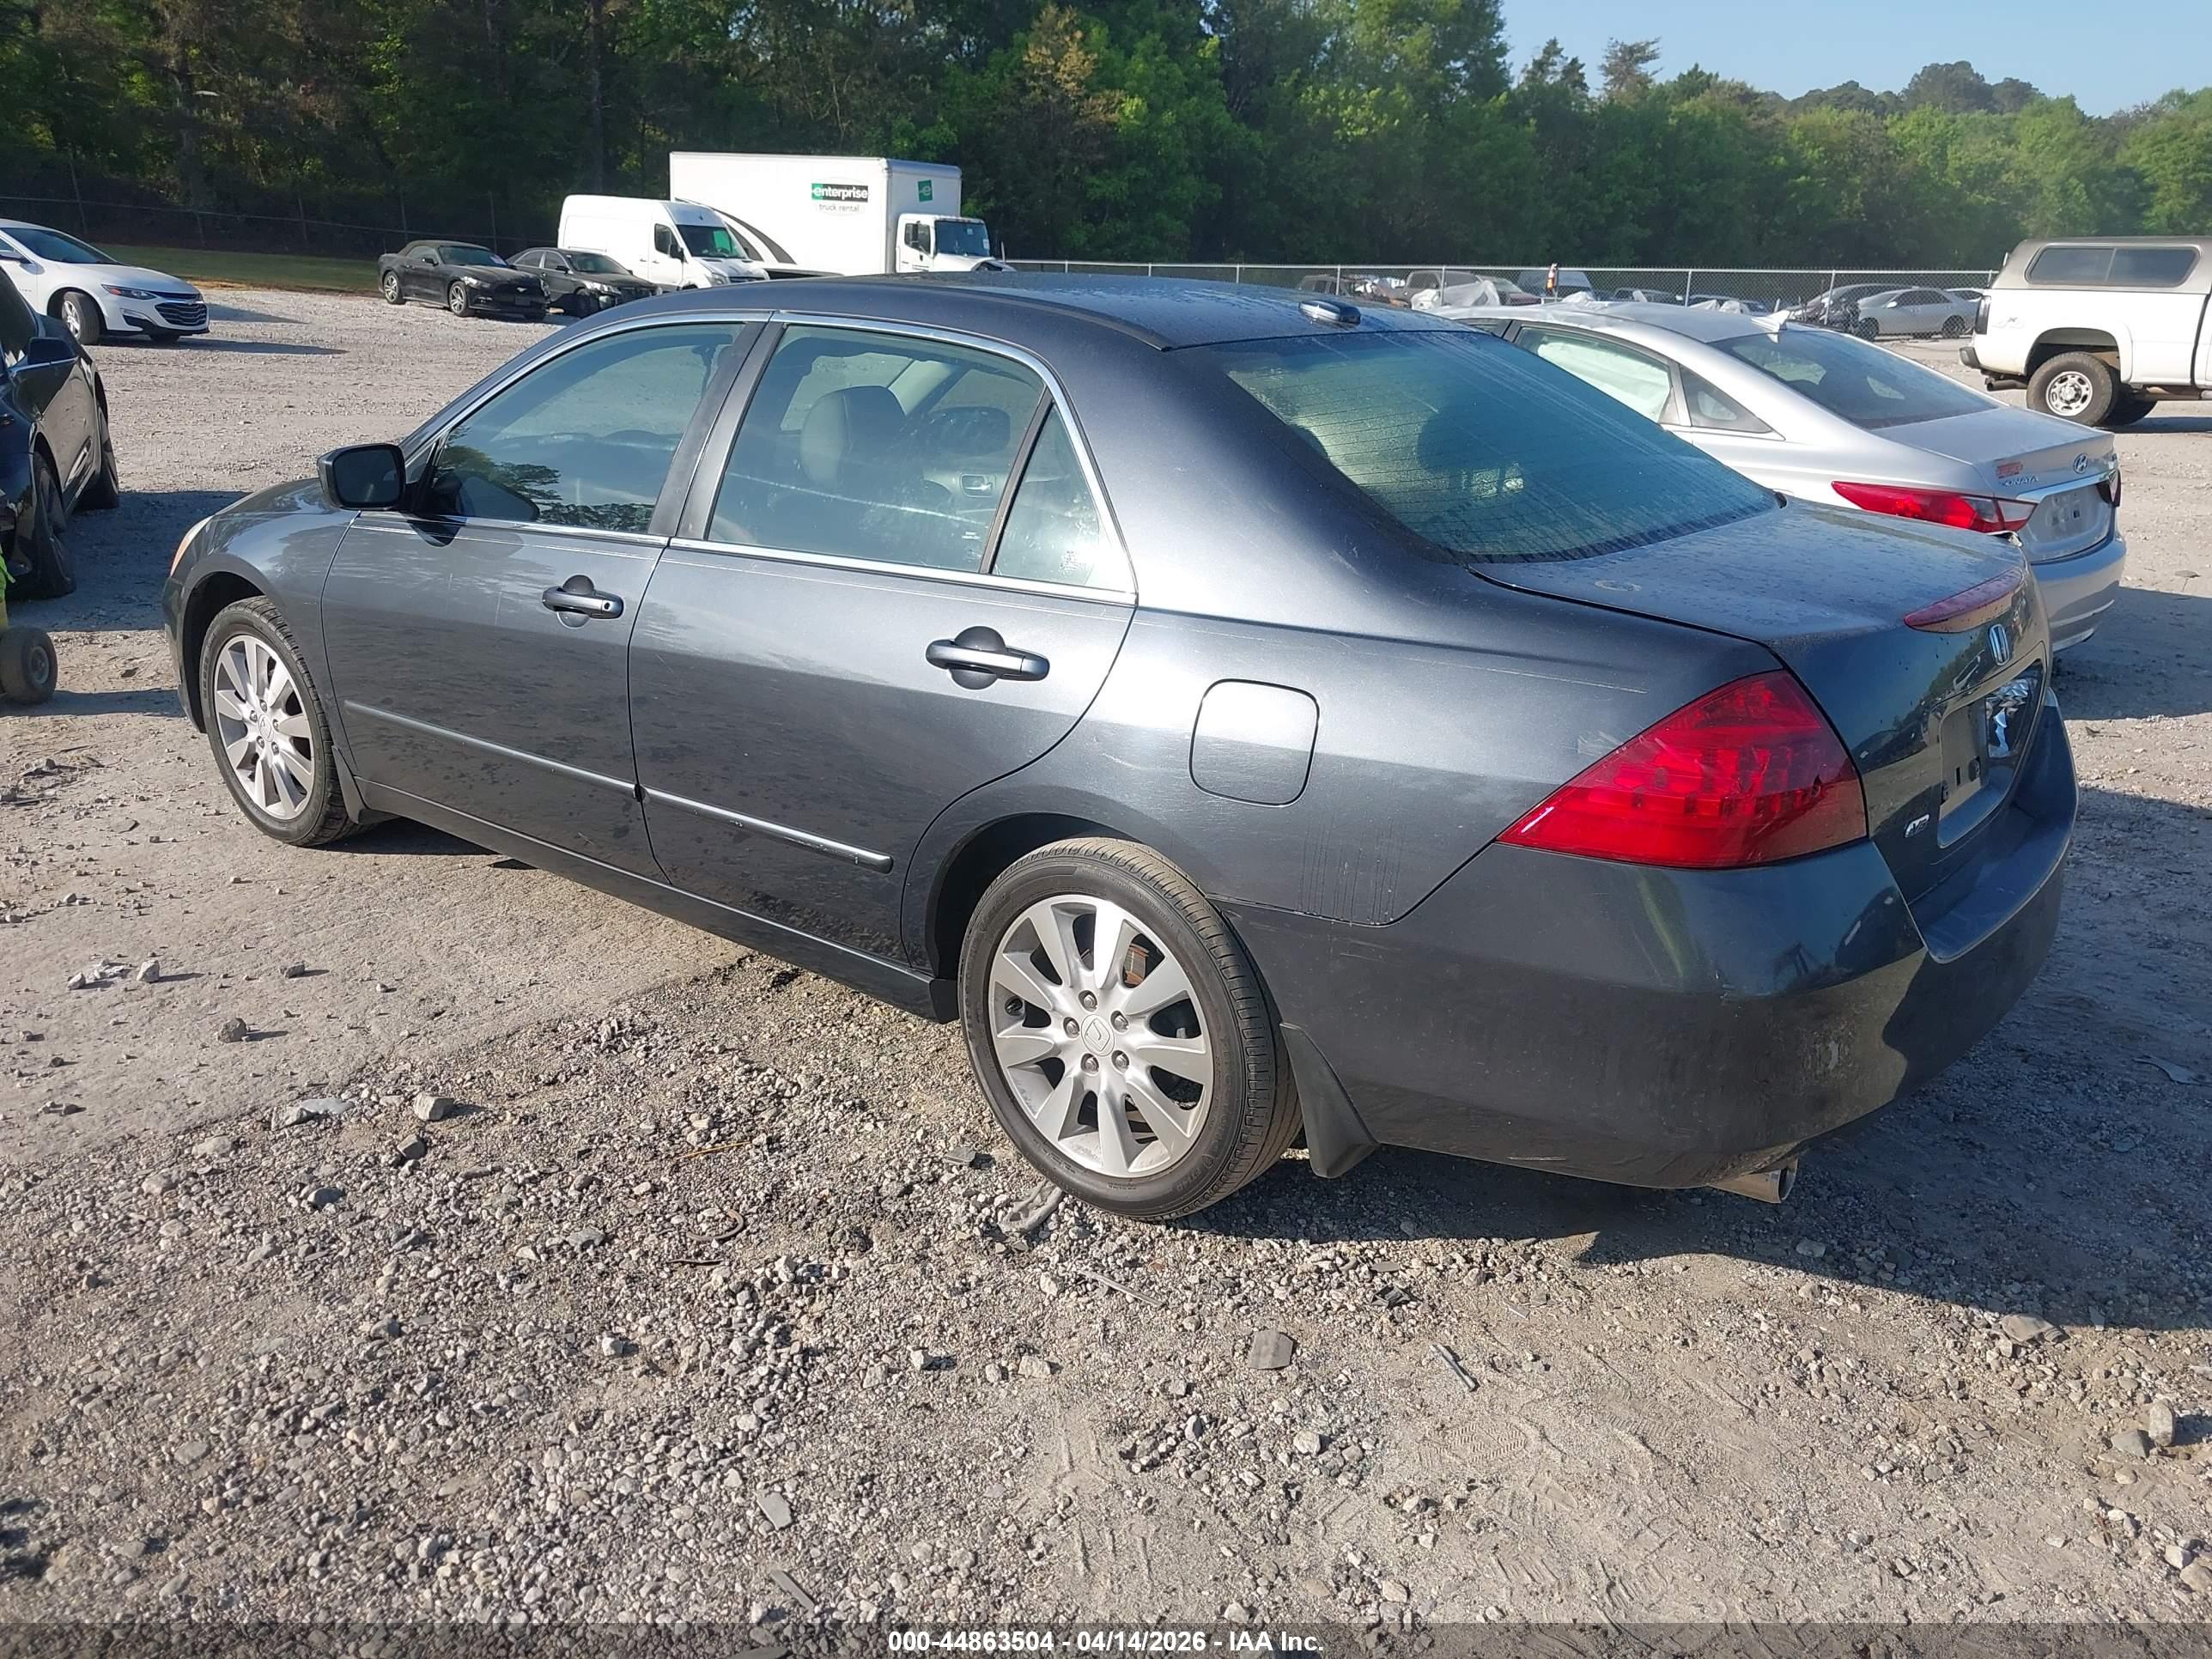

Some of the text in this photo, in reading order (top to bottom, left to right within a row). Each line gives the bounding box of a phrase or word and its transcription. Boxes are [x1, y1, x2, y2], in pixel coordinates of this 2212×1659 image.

[811, 185, 868, 202] enterprise
[818, 204, 860, 213] truck rental
